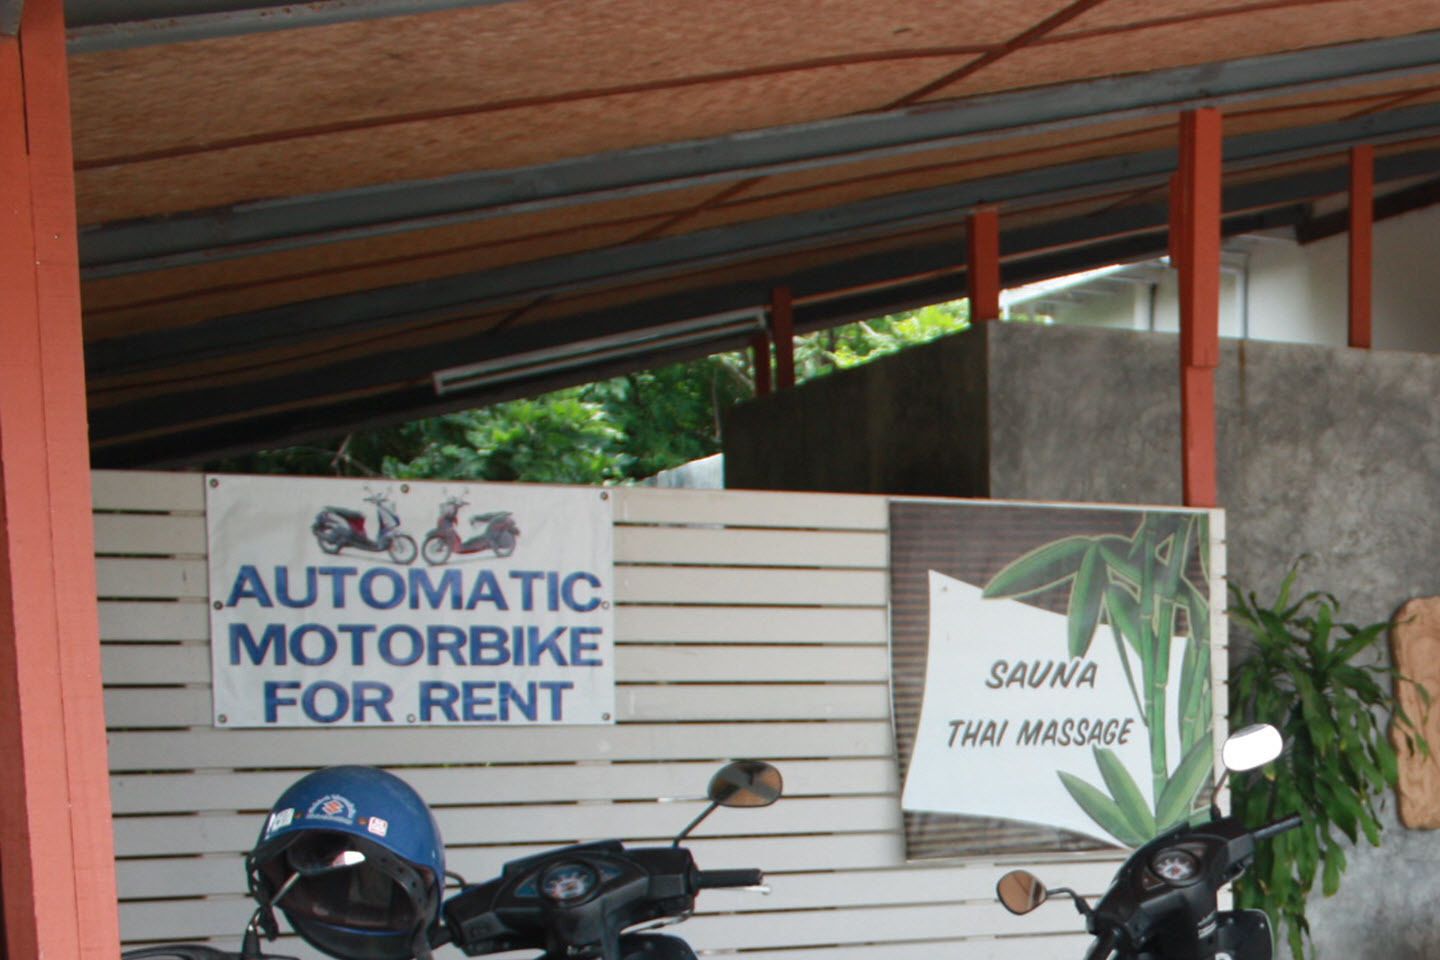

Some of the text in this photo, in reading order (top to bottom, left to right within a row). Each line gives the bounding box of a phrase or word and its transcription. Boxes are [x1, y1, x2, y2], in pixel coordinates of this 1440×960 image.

[225, 564, 602, 612] AUTOMATIC
[228, 623, 603, 667] MOTORBIKE
[985, 659, 1098, 689] SAUNA
[263, 680, 574, 724] FOR RENT
[948, 718, 1134, 748] THAI MASSAGE
